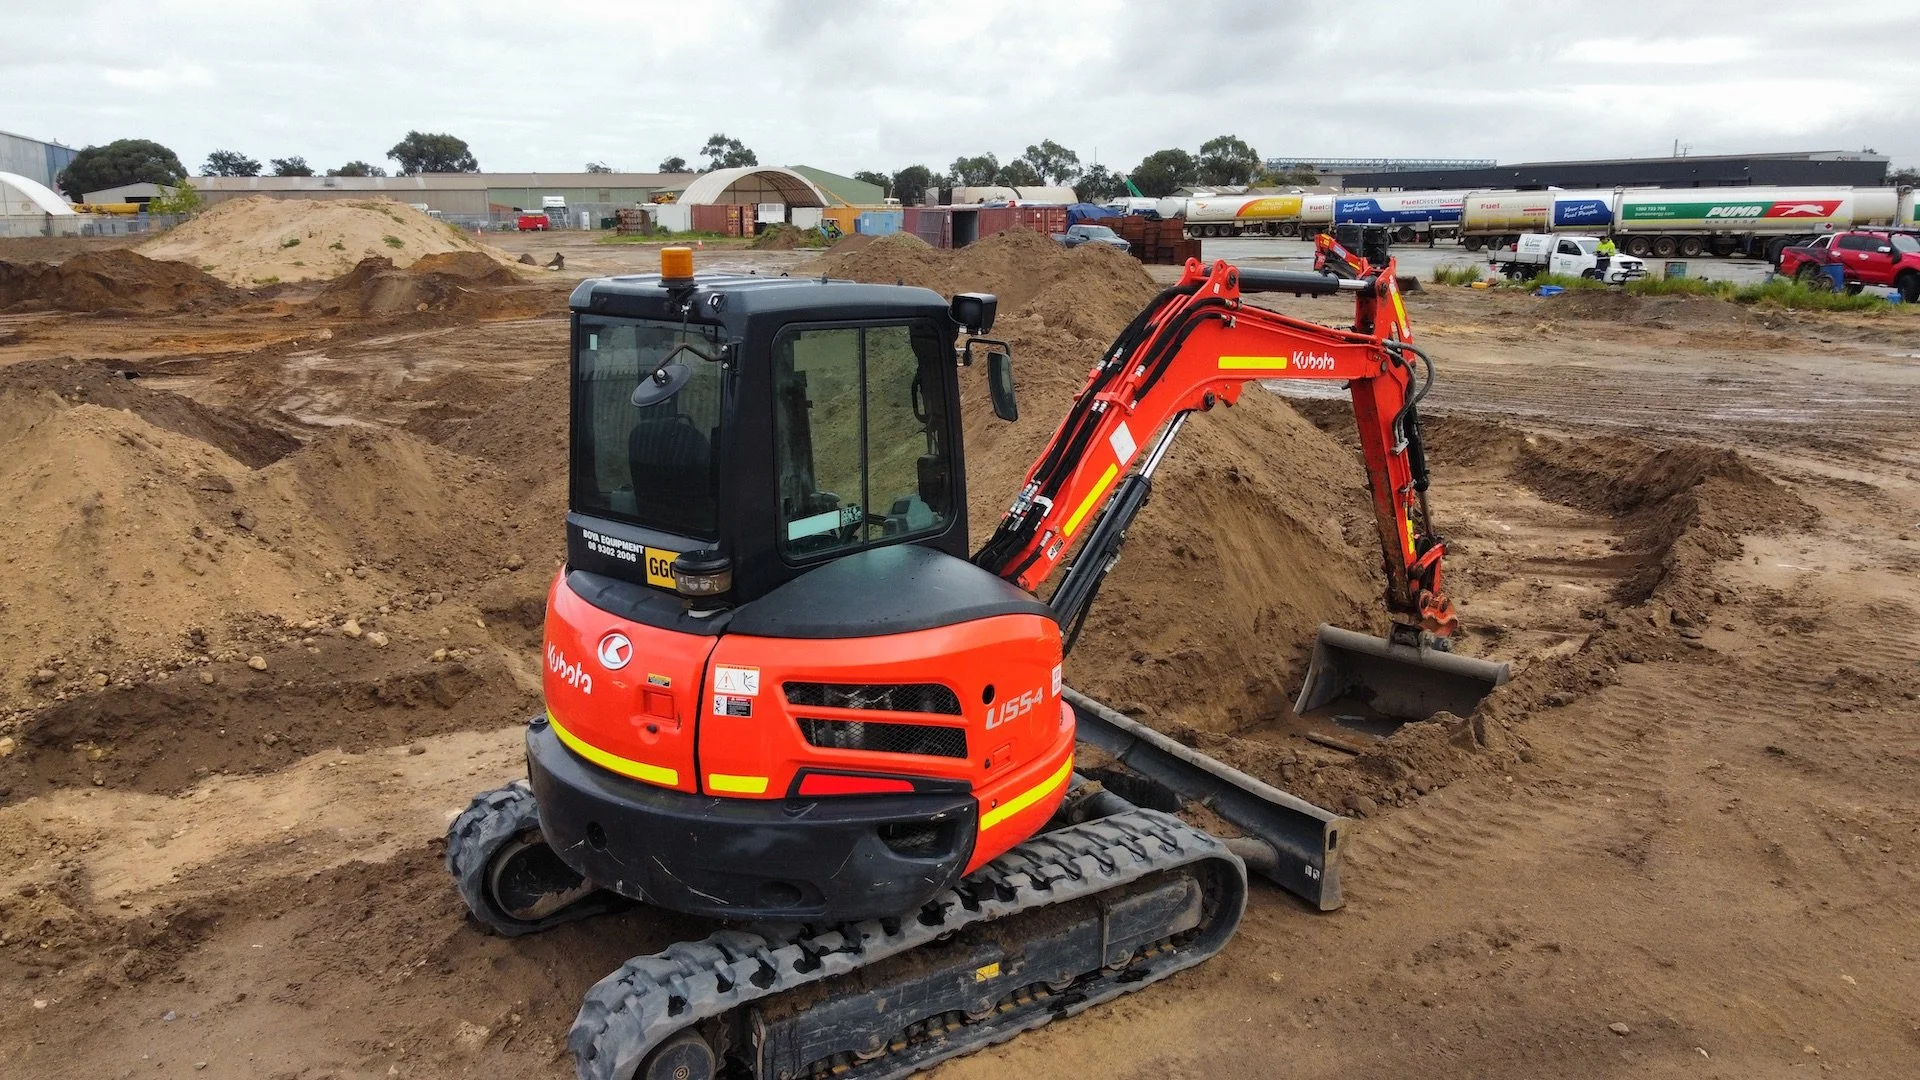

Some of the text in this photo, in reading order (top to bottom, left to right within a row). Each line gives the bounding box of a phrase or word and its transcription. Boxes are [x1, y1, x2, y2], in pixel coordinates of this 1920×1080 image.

[1563, 208, 1598, 219] Fuel People
[1565, 202, 1597, 213] Your Local
[1705, 206, 1763, 217] PUMA
[1292, 350, 1335, 371] Kubota
[582, 529, 645, 555] BOYA EQUIPMENT
[588, 541, 637, 562] 08 9302 2006
[547, 641, 593, 695] Kubota
